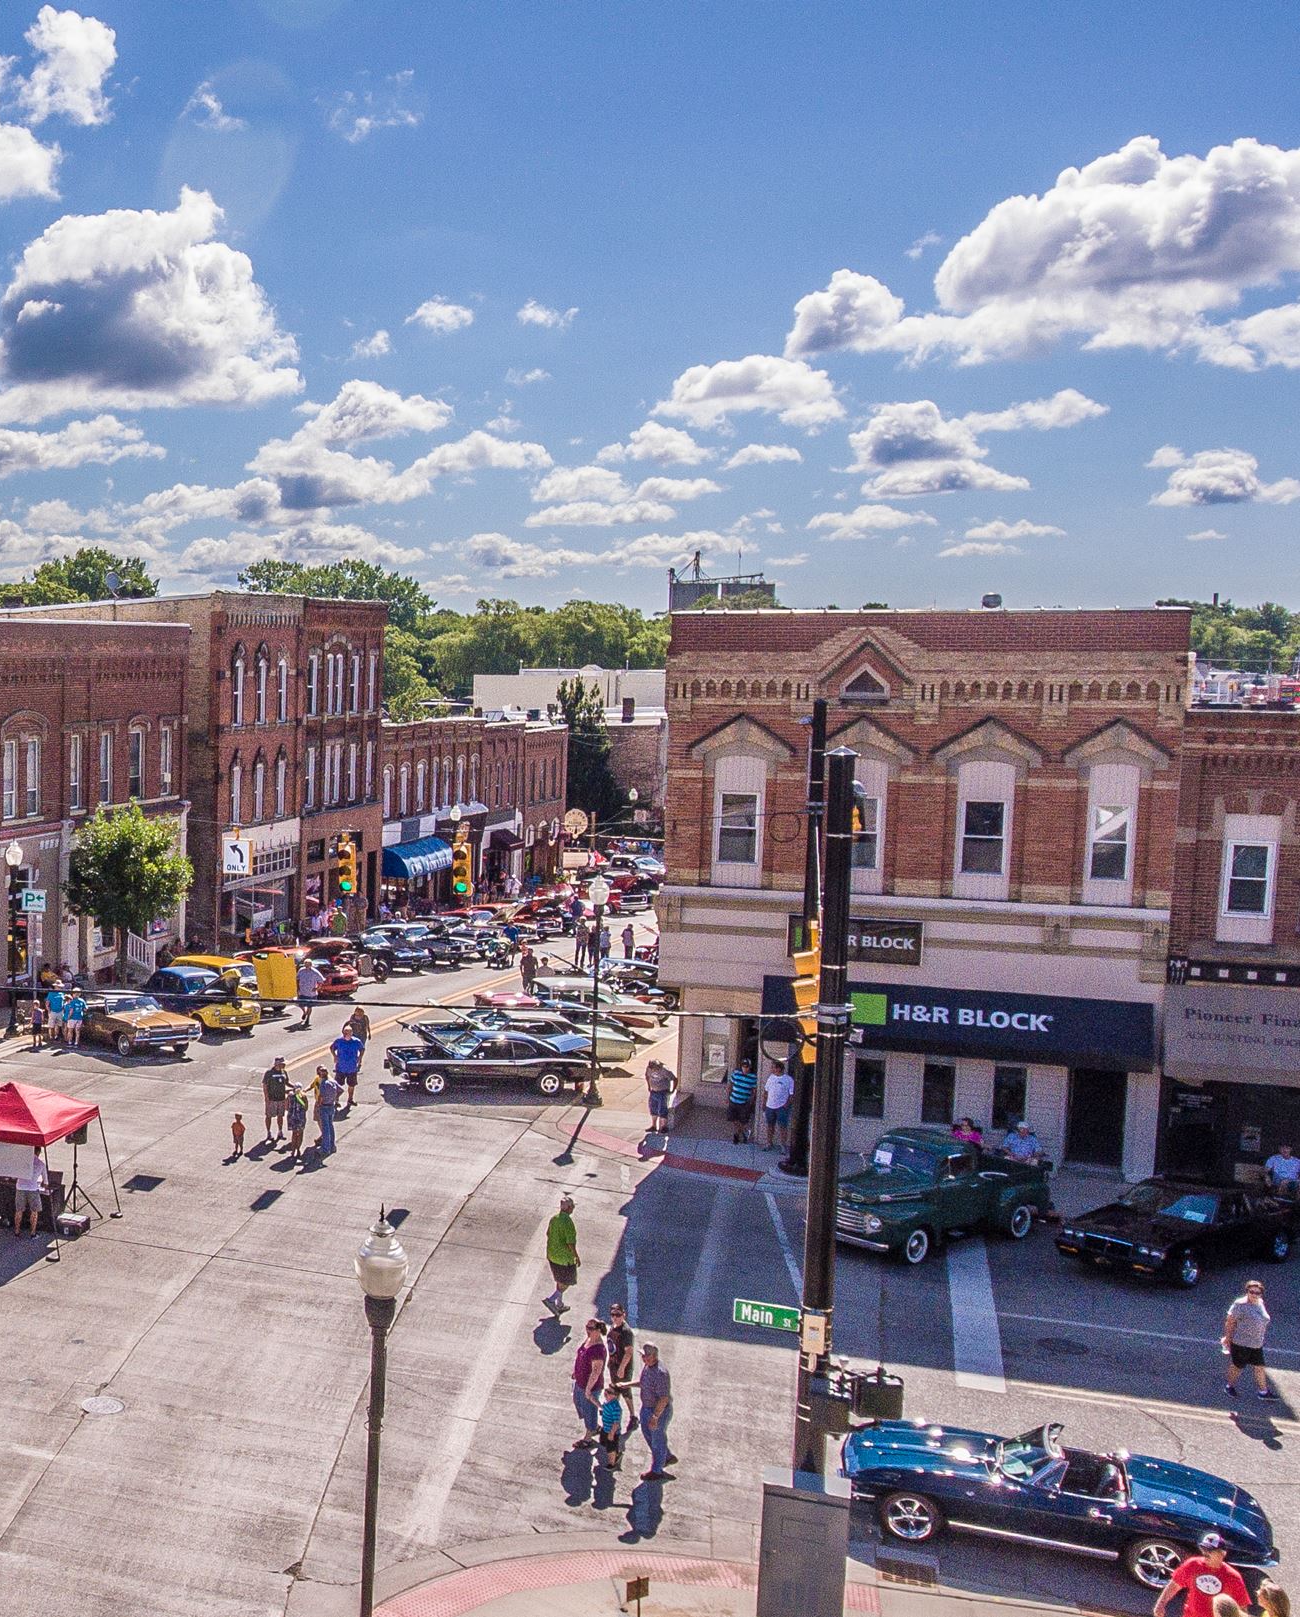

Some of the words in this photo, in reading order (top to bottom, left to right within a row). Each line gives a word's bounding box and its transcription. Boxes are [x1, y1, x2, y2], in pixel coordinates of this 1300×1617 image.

[226, 863, 246, 872] ONLY
[861, 935, 916, 950] BLOCK
[892, 1003, 950, 1025] H&R
[958, 1008, 1050, 1033] BLOCK
[1184, 1007, 1252, 1024] Pioneer
[741, 1303, 773, 1325] Main
